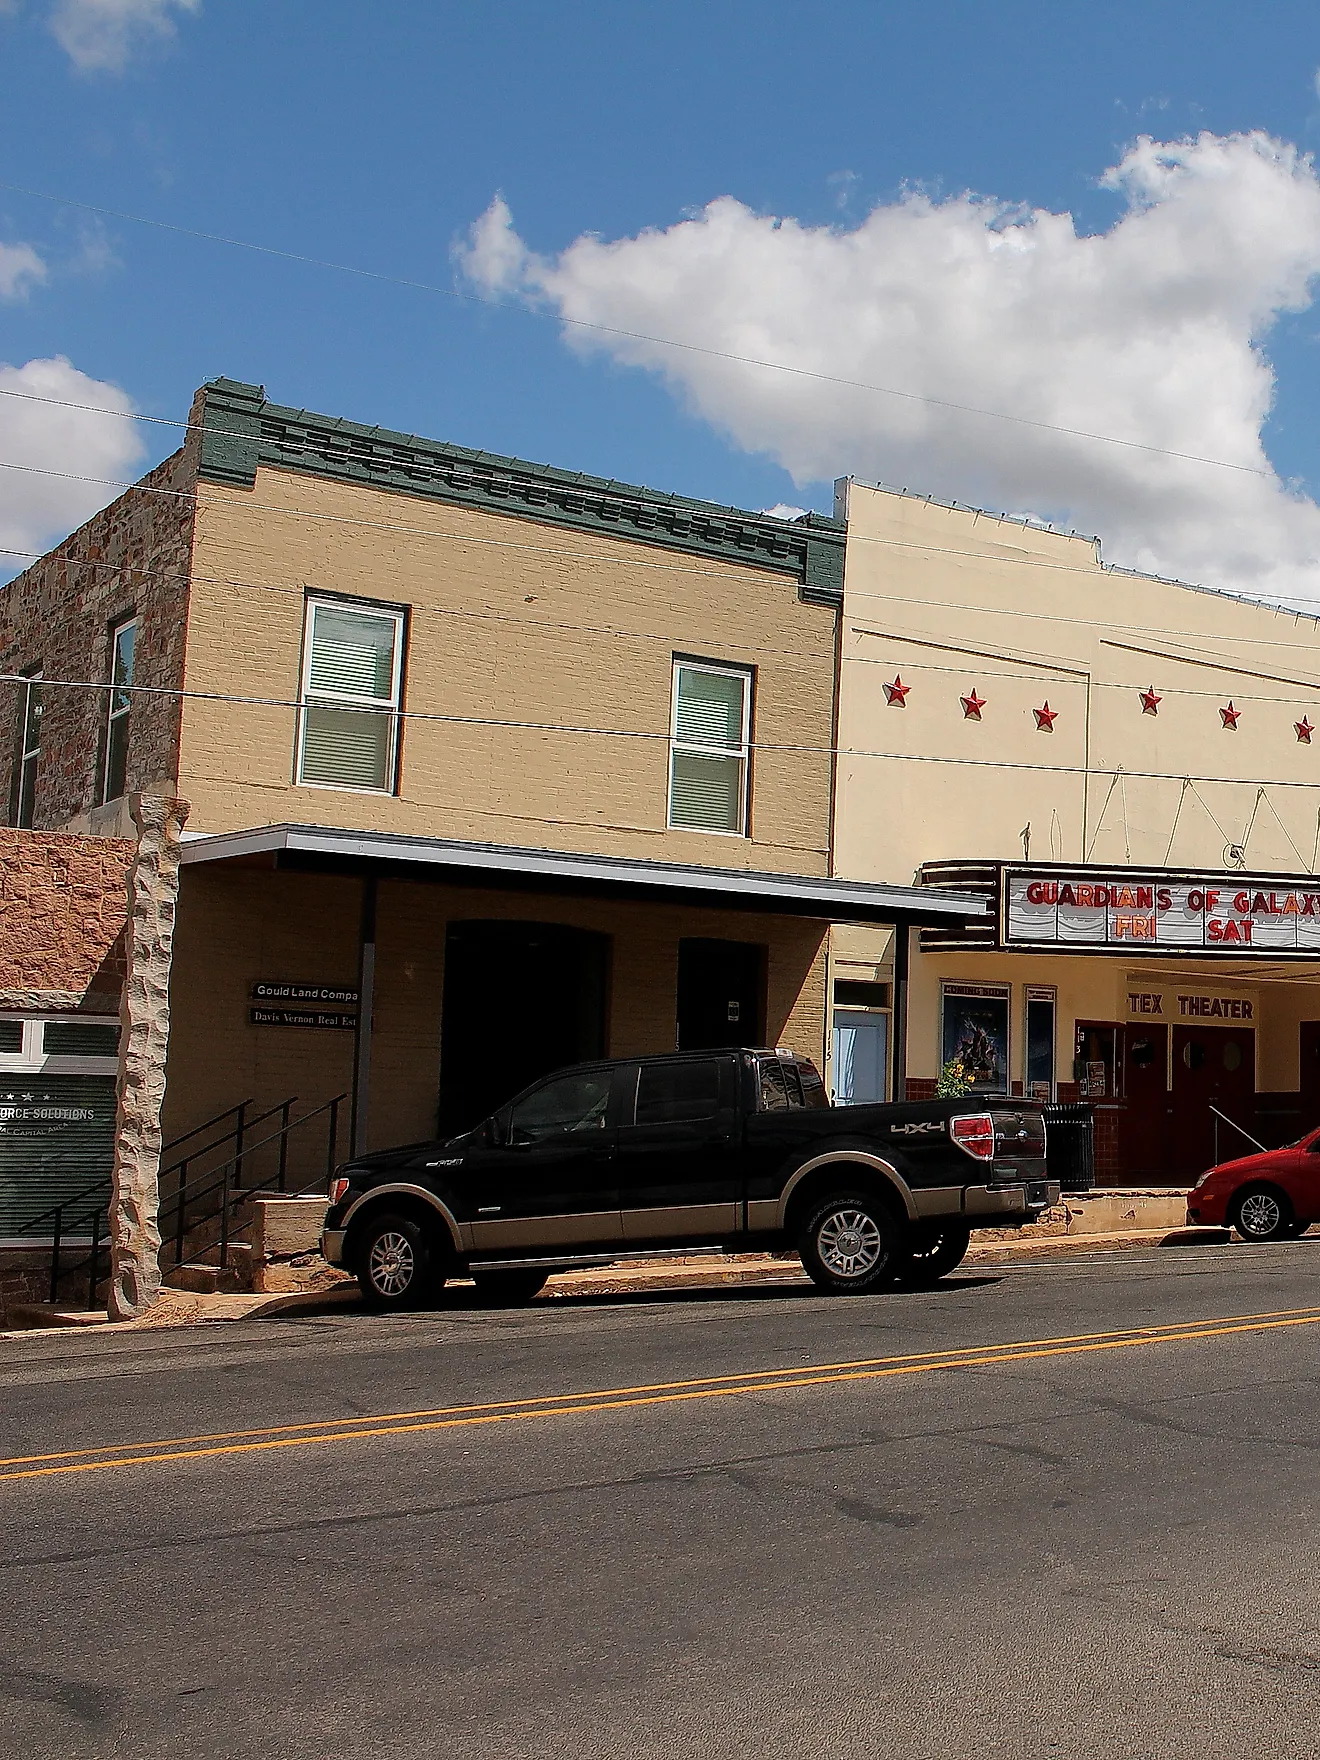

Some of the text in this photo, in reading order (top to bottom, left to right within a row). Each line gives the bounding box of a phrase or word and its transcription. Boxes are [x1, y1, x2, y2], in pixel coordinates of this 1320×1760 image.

[1027, 882, 1172, 911] GUARDIANS
[1187, 890, 1220, 912] OF
[1116, 914, 1254, 944] FRI SAT
[257, 985, 358, 1002] Gould Land Compa
[1128, 993, 1253, 1020] TEX THEATER
[255, 1011, 280, 1021] Davis
[283, 1013, 314, 1024] Vernon
[318, 1016, 338, 1025] Real
[32, 1108, 95, 1120] SOLUTIONS
[890, 1120, 946, 1135] 4X4
